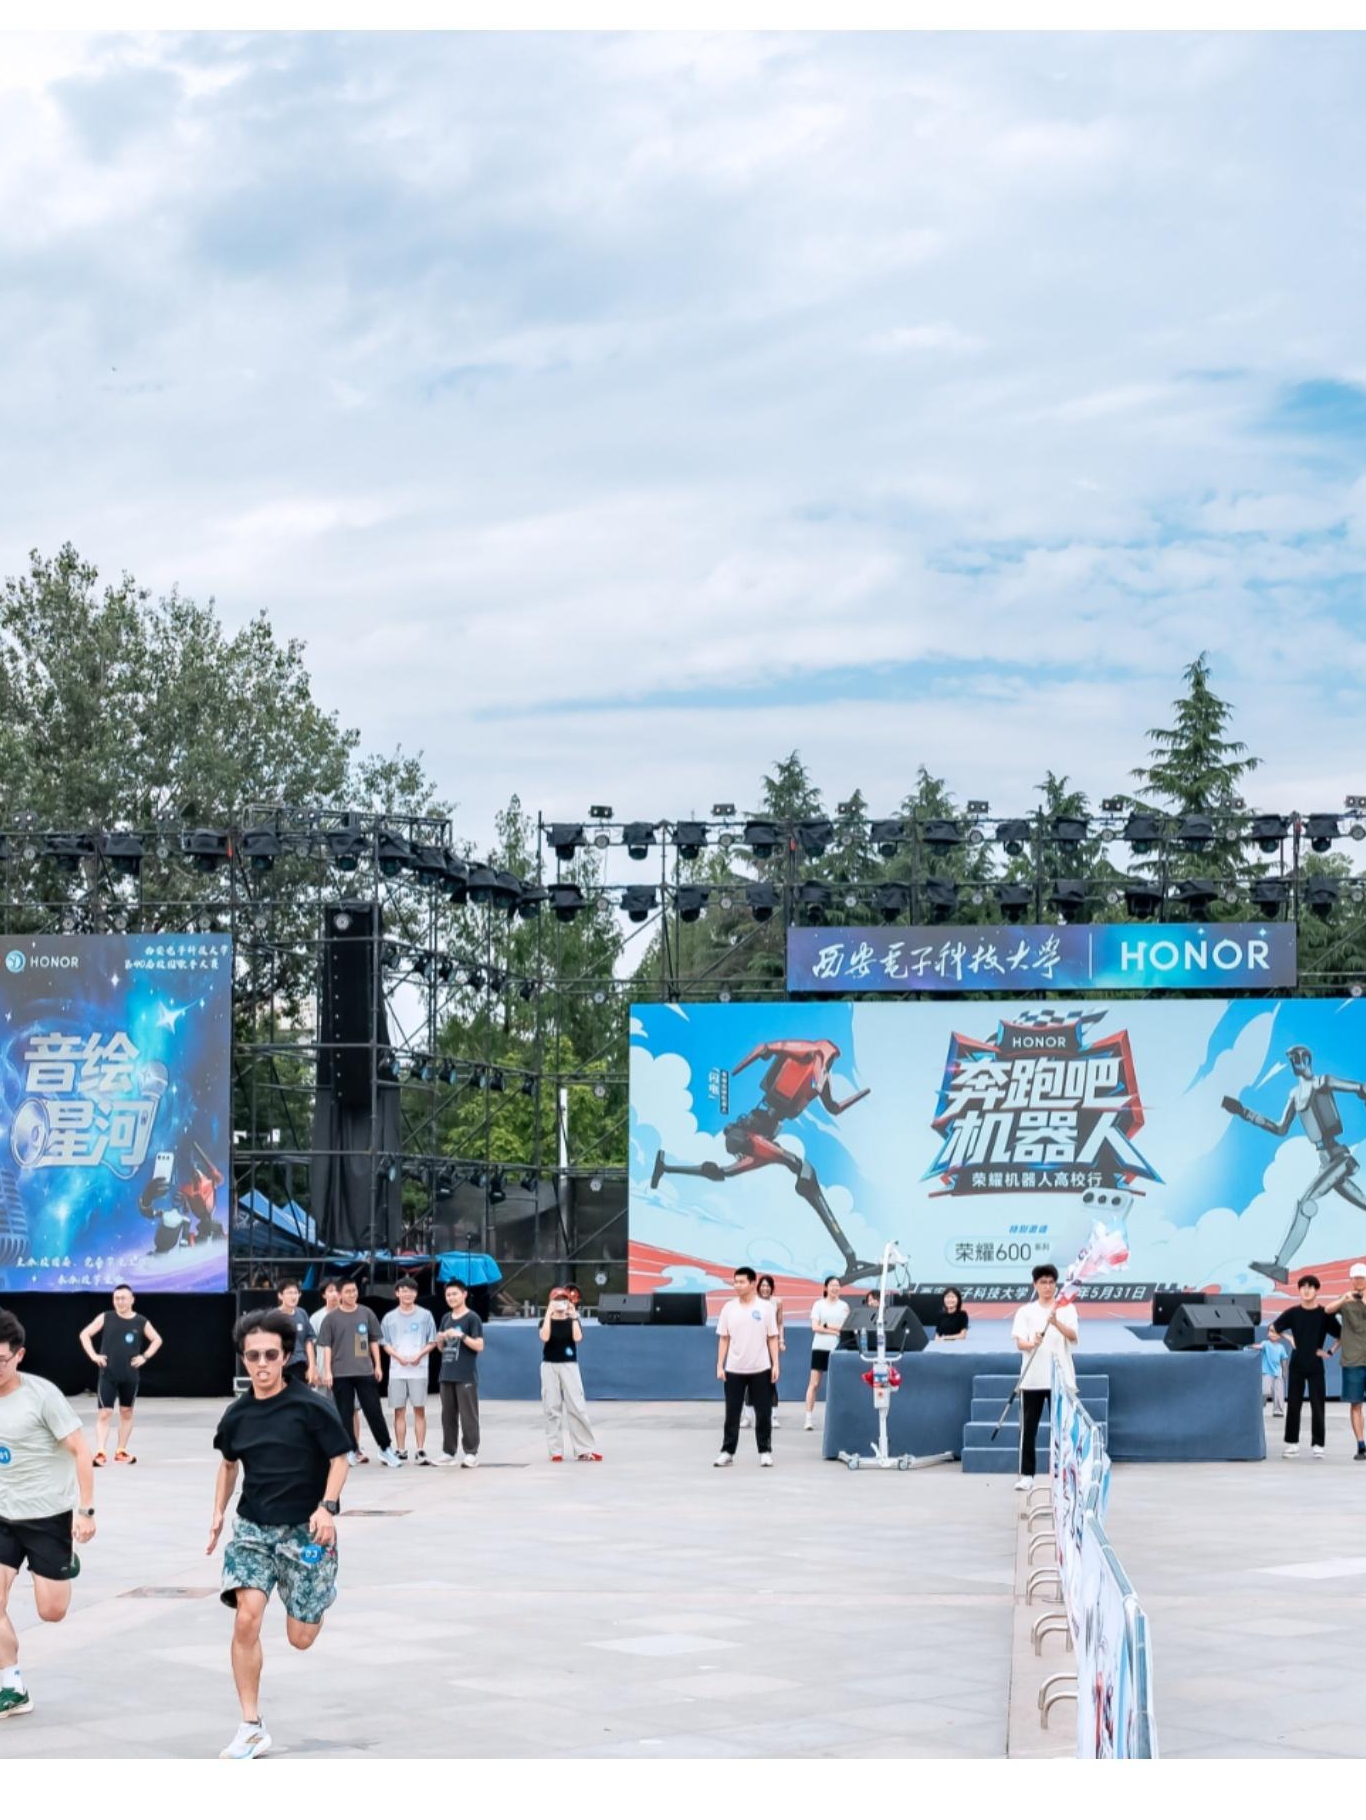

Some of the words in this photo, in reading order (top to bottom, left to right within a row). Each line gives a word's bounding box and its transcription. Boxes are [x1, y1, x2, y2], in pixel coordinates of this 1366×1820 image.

[29, 955, 79, 969] HONOR
[1120, 939, 1270, 972] HONOR
[1012, 1036, 1067, 1049] HONOR
[24, 1031, 140, 1093] 音绘
[938, 1056, 1135, 1117] 奔跑吧
[43, 1099, 155, 1167] 星河
[933, 1110, 1155, 1175] 机器人
[971, 1171, 1103, 1189] 荣耀机器人高校行
[955, 1242, 1031, 1262] 荣耀600
